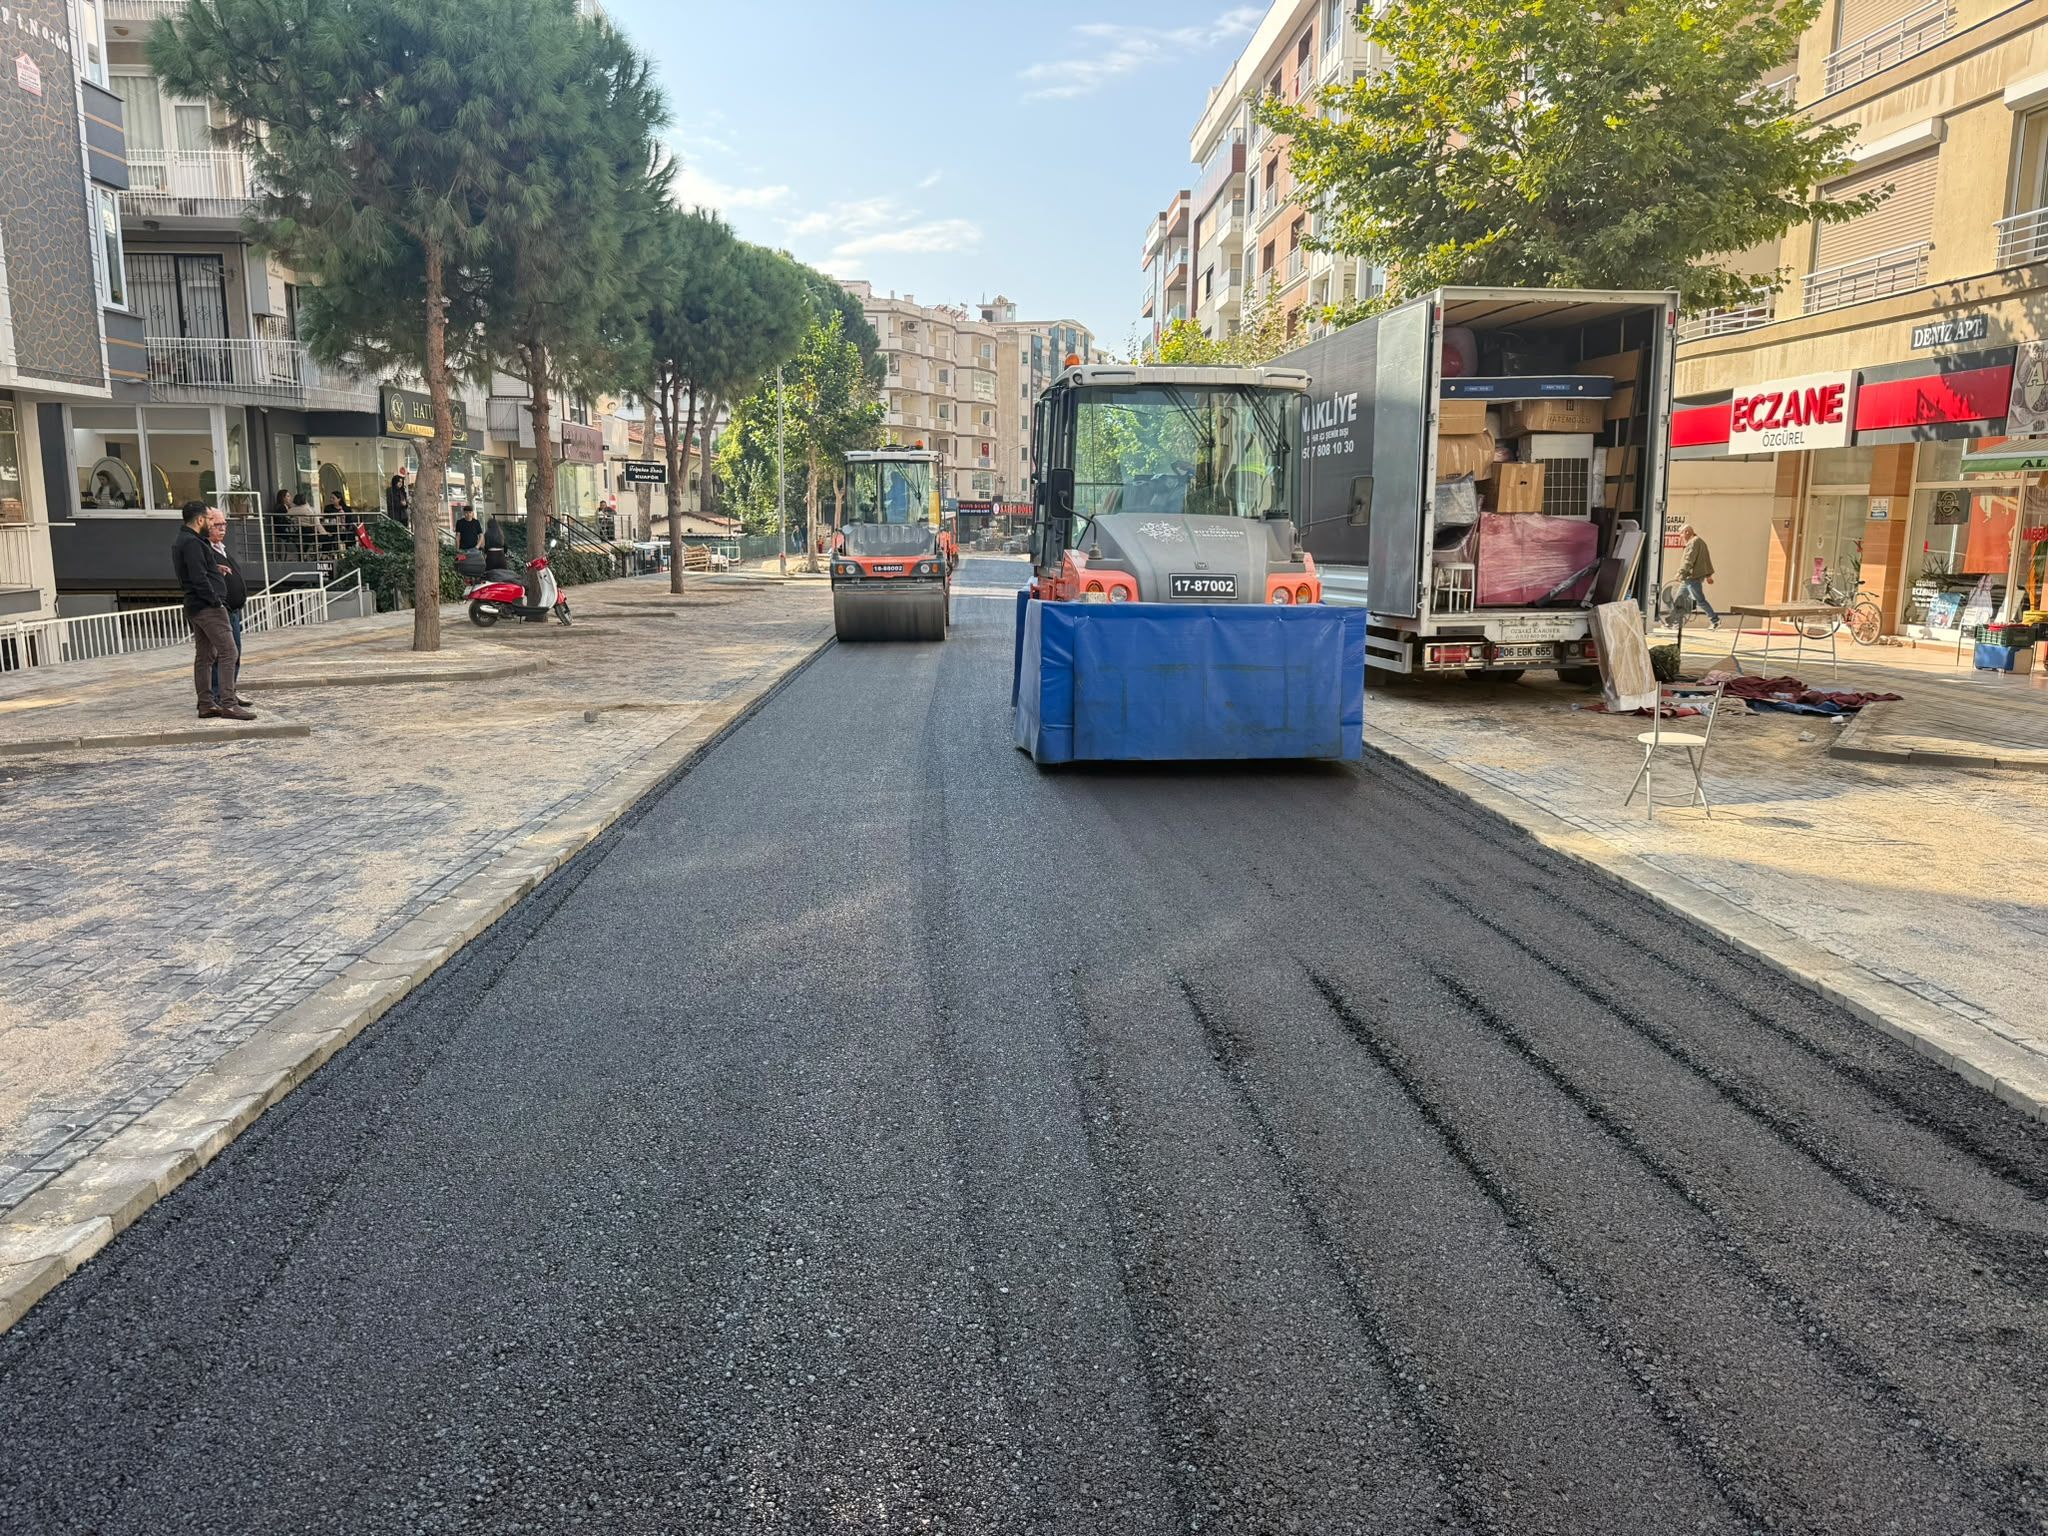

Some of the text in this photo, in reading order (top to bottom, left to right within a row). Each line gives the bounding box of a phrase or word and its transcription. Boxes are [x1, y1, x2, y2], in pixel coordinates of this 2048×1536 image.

[1913, 318, 1983, 348] DENİZ APT.
[412, 401, 434, 420] HATU
[1732, 383, 1845, 432] ECZANE
[1762, 430, 1805, 447] ÖZGÜREL
[1316, 443, 1331, 457] 808
[1332, 441, 1343, 455] 10
[1343, 439, 1354, 453] 30
[1175, 580, 1234, 592] 17-87002
[1504, 646, 1551, 657] 06 EGK 655
